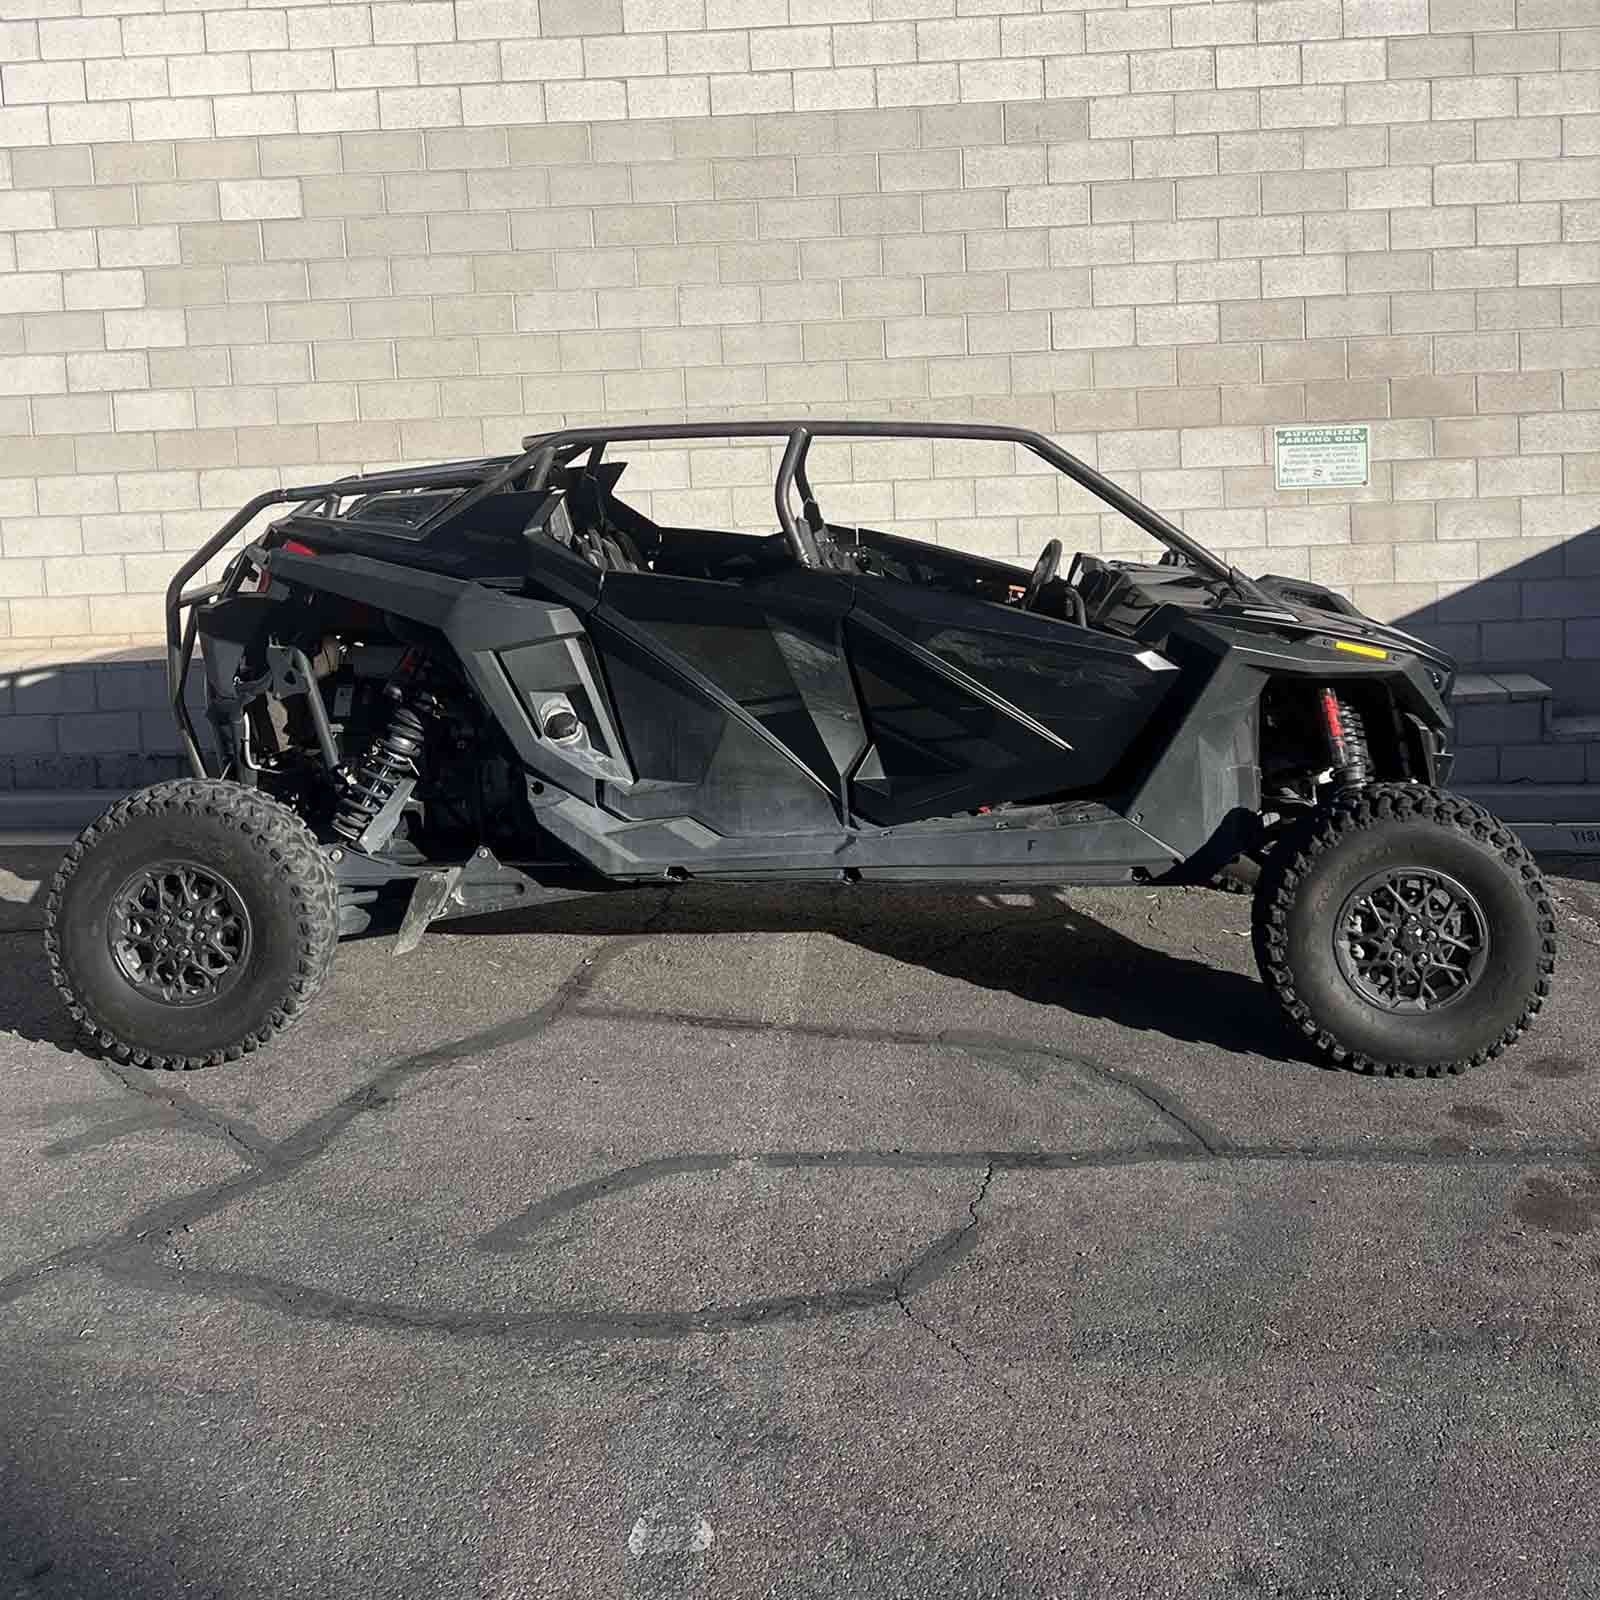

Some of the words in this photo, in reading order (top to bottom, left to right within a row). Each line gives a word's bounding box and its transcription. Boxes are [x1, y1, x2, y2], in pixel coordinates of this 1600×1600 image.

[1284, 429, 1361, 437] AUTHORIZED
[1278, 436, 1332, 444] PARKING
[1334, 434, 1366, 443] ONLY
